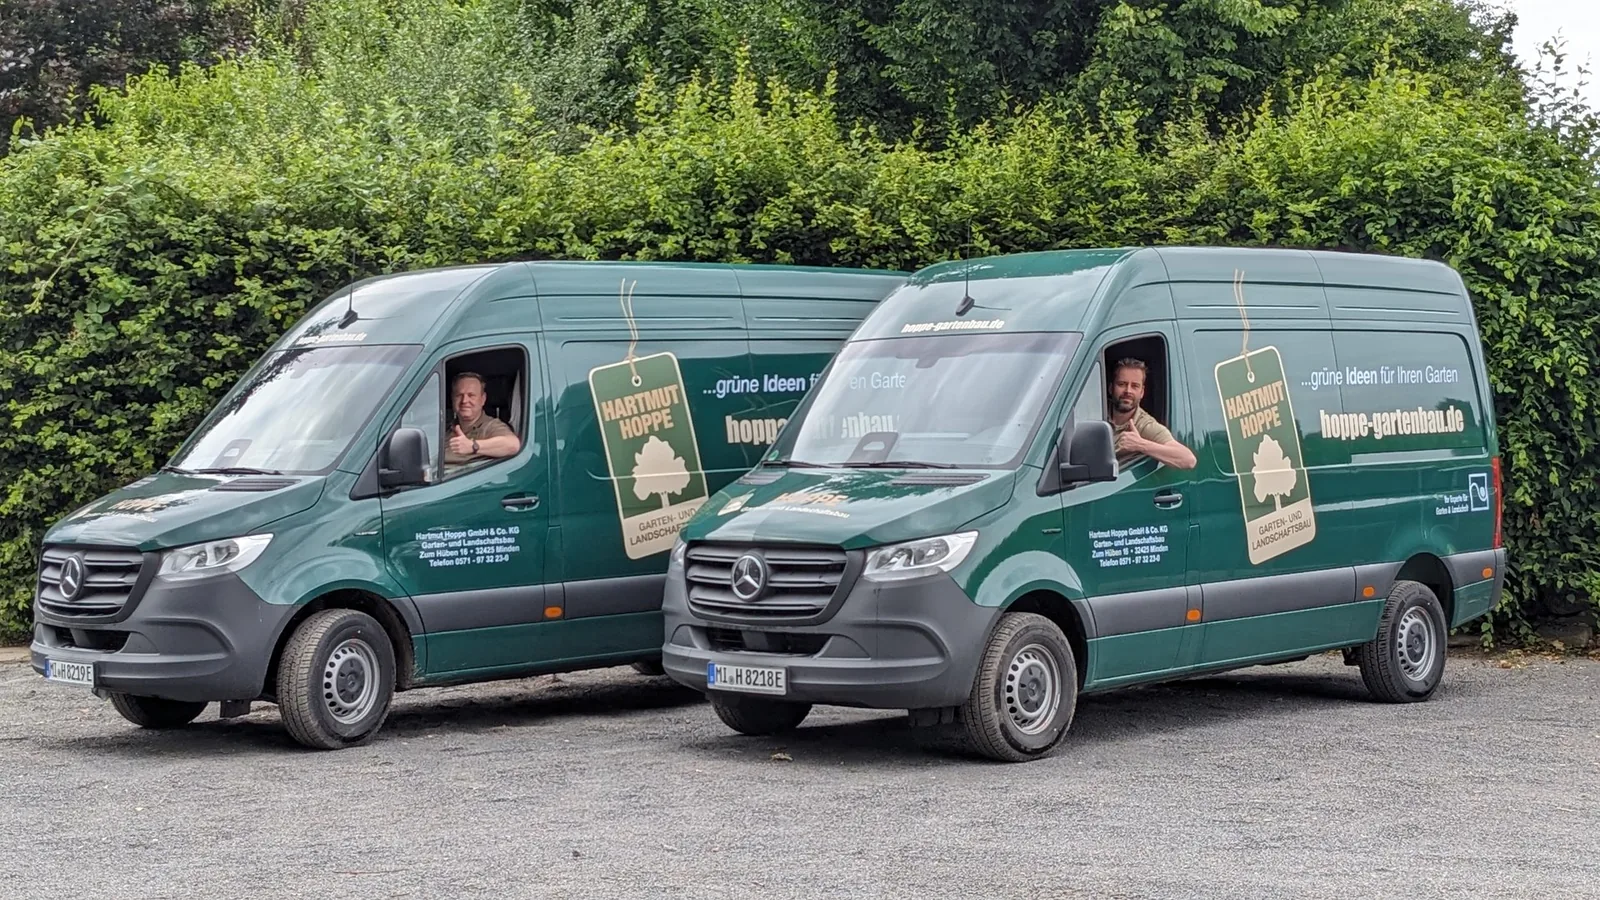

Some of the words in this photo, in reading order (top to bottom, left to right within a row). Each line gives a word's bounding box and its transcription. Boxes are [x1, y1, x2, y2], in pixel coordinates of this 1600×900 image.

[901, 319, 1005, 333] hoppe-gartenbau.de
[703, 376, 759, 399] ...grüne
[763, 374, 806, 393] Ideen
[871, 371, 906, 390] Garte
[1301, 367, 1343, 391] ...grüne
[1346, 366, 1378, 385] Ideen
[1380, 366, 1394, 384] für
[1397, 365, 1423, 384] Ihren
[1425, 365, 1458, 384] Garten
[601, 384, 680, 422] HARTMUT
[1225, 380, 1284, 420] HARTMUT
[619, 408, 674, 440] HOPPE
[1240, 405, 1282, 439] HOPPE
[1319, 405, 1464, 441] hoppe-gartenbau.de
[639, 514, 677, 531] GARTEN-
[1259, 517, 1287, 535] GARTEN-
[1288, 510, 1303, 523] UND
[415, 532, 443, 541] Hartmut
[444, 530, 467, 540] Hoppe
[468, 528, 488, 537] GmbH
[490, 527, 495, 536] &
[496, 527, 507, 536] Co.
[508, 526, 520, 534] KG
[1089, 530, 1110, 539] Hartmut
[1111, 529, 1128, 538] Hoppe
[1129, 527, 1144, 535] GmbH
[1145, 526, 1150, 534] &
[1150, 526, 1159, 534] Co.
[1160, 525, 1168, 533] KG
[1252, 518, 1312, 550] LANDSCHAFTSBAU
[421, 541, 447, 550] Garten-
[448, 539, 461, 547] und
[463, 536, 515, 546] Landschaftsbau
[1093, 540, 1113, 548] Garten-
[1125, 535, 1165, 546] Landschaftsbau
[419, 551, 435, 559] Zum
[436, 548, 458, 558] Hüben
[475, 546, 495, 555] 32425
[496, 545, 520, 554] Minden
[1092, 550, 1104, 558] Zum
[1104, 548, 1122, 557] Hüben
[1135, 546, 1149, 554] 32425
[1150, 544, 1168, 553] Minden
[429, 557, 454, 567] Telefon
[455, 555, 471, 565] 0571
[476, 555, 484, 564] 97
[486, 554, 494, 563] 32
[495, 554, 509, 563] 23-0
[1100, 557, 1118, 567] Telefon
[1119, 556, 1131, 565] 0571
[716, 666, 728, 683] MI
